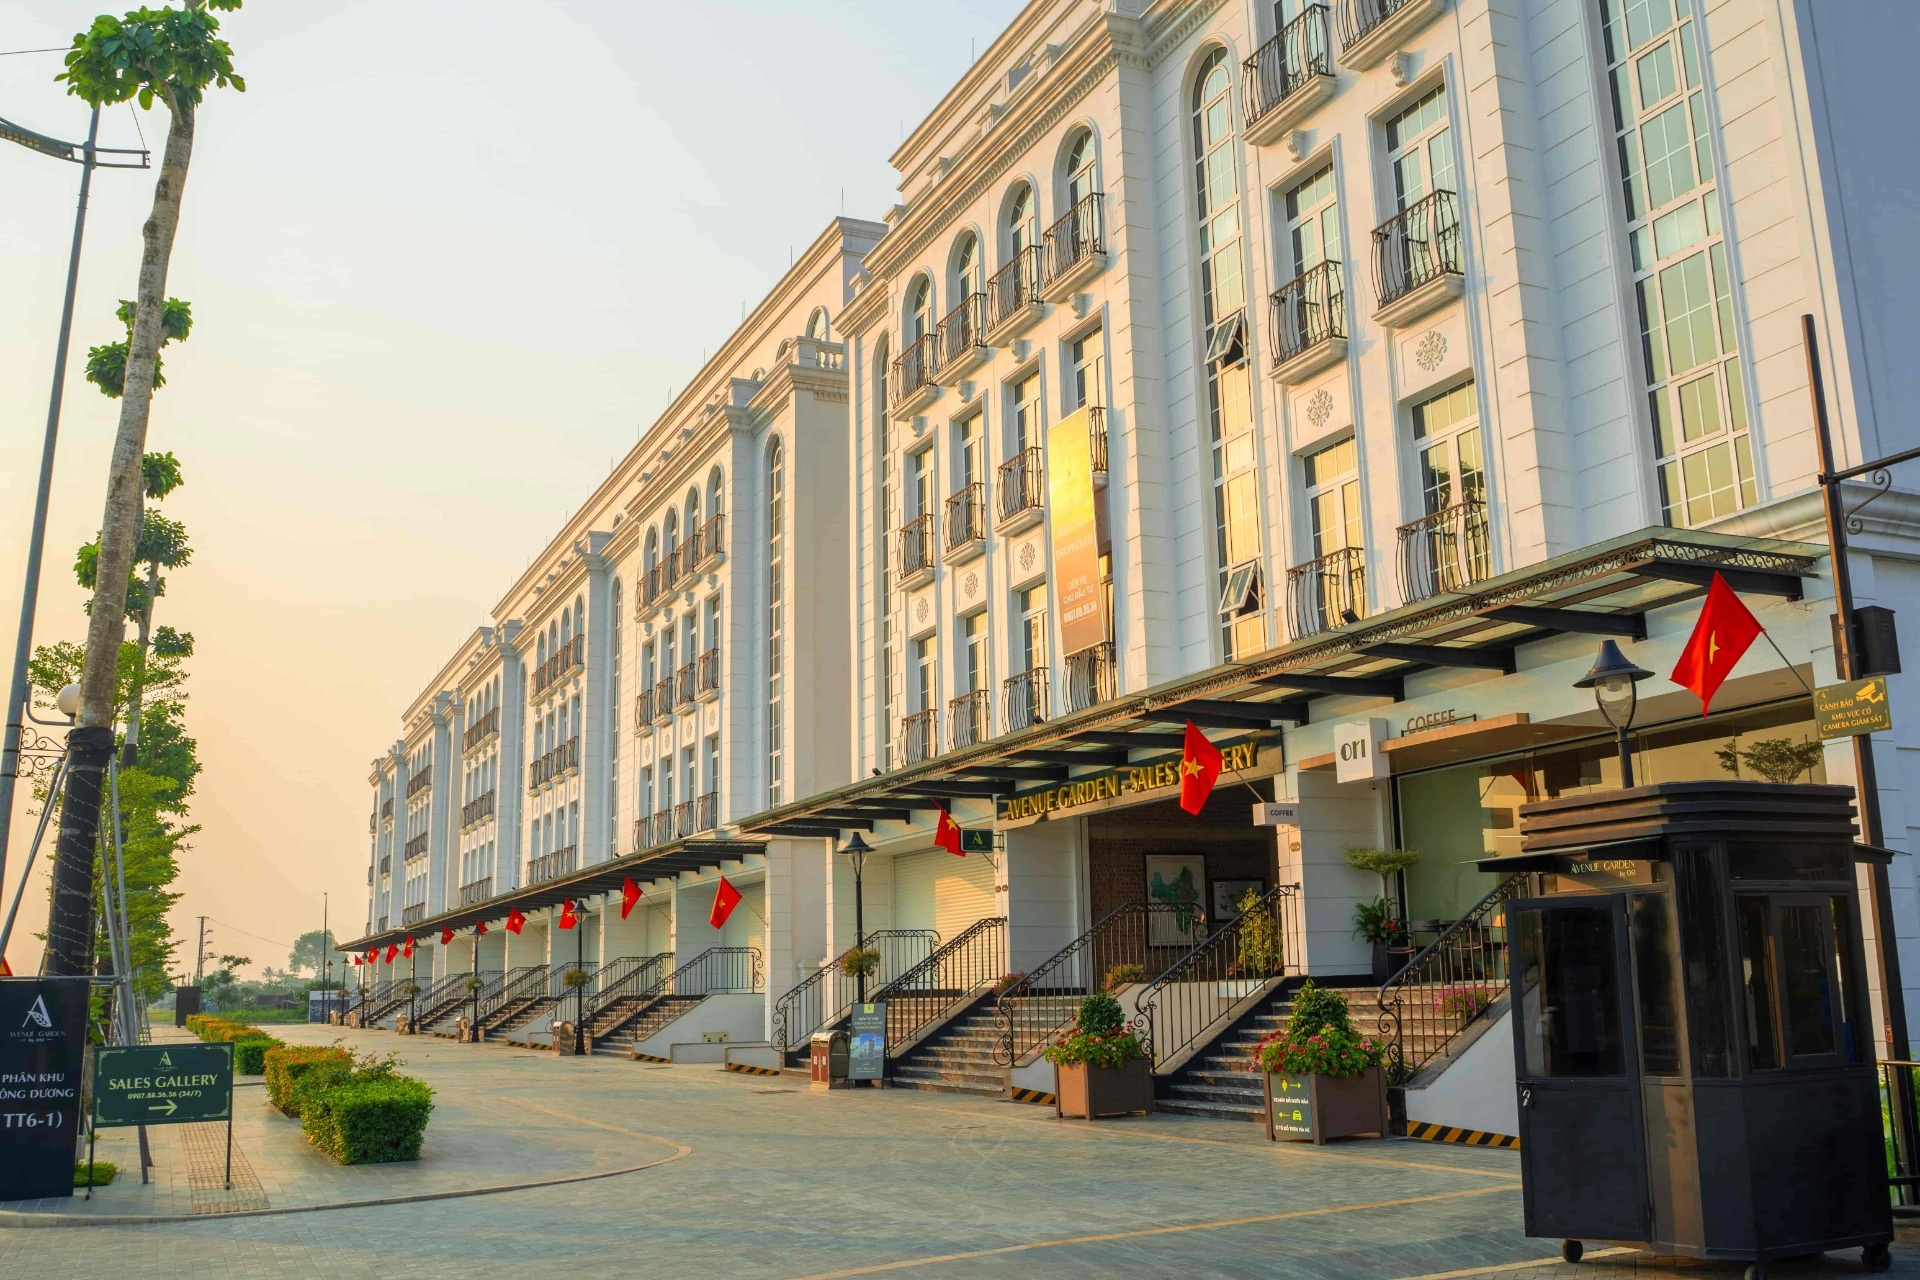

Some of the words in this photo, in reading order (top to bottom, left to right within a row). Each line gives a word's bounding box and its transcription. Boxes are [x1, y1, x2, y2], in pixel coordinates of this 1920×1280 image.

[1406, 708, 1456, 734] COFFEE
[1831, 711, 1846, 721] KHU
[1861, 706, 1872, 715] CÓ
[1823, 721, 1850, 731] CAMERA
[1851, 717, 1870, 727] GIÁM
[1007, 789, 1056, 820] AVENUE
[1058, 774, 1120, 808] GARDEN
[1130, 761, 1176, 793] SALES
[1270, 809, 1294, 817] COFFEE
[1571, 862, 1601, 874] AVENUE
[1603, 859, 1635, 871] GARDEN
[2, 1071, 36, 1083] PHÂN
[39, 1073, 65, 1082] KHU
[109, 1076, 151, 1090] SALES
[155, 1073, 218, 1088] GALLERY
[0, 1087, 26, 1099] ÔNG
[29, 1087, 75, 1099] DƯƠNG
[127, 1091, 177, 1099] 0907.88.36.36
[178, 1090, 202, 1098] (24/7)
[3, 1111, 63, 1129] TT6-1)
